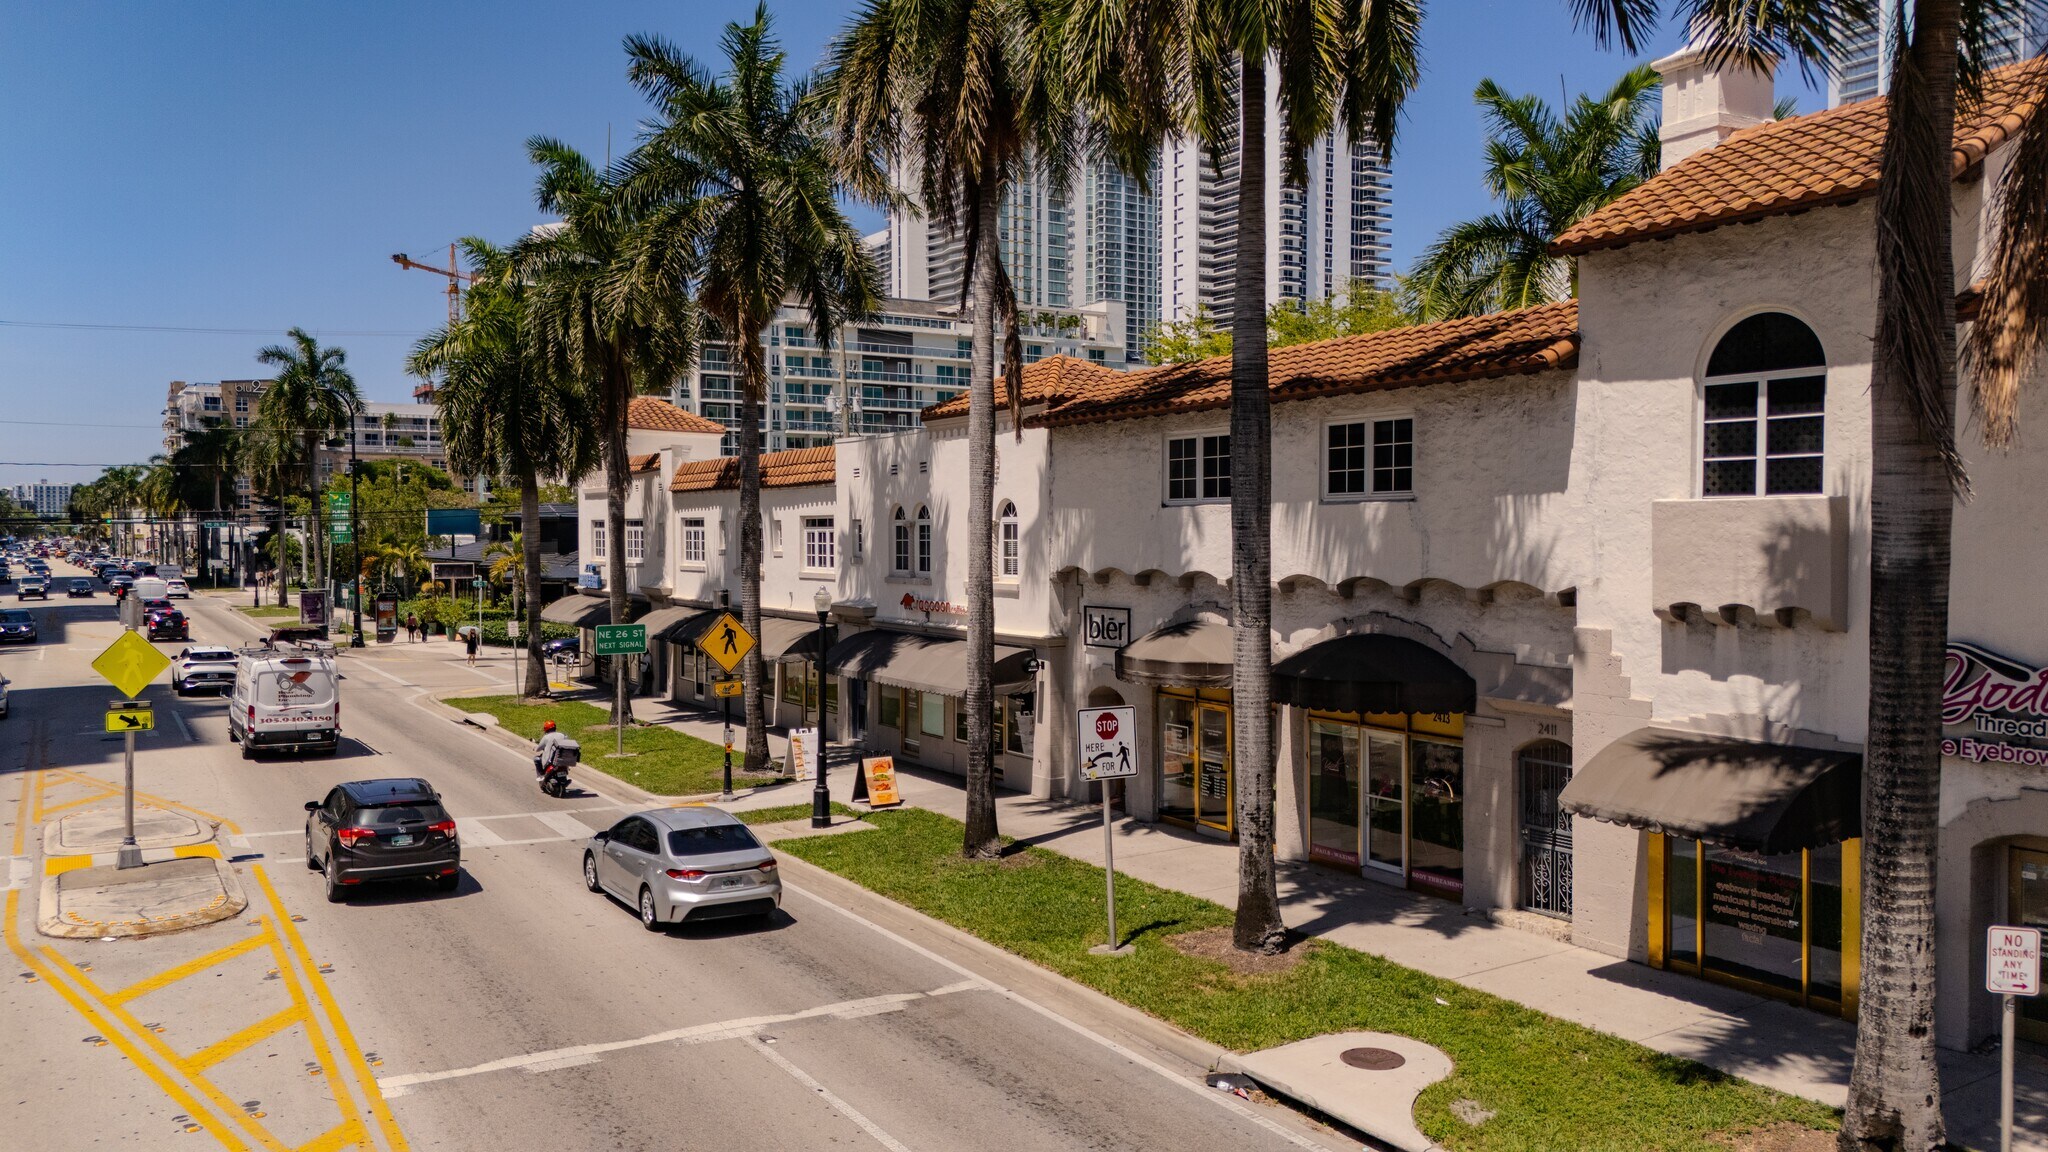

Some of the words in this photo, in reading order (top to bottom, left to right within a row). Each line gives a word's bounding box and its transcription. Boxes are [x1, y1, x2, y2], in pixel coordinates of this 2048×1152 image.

[915, 599, 951, 612] raccoon
[599, 630, 611, 639] NE
[616, 630, 628, 639] 26
[633, 629, 644, 638] ST
[1089, 614, 1126, 641] blēr
[620, 640, 644, 649] SIGNAL
[260, 716, 333, 724] 305.940.8180
[1433, 712, 1451, 725] 2413
[1097, 720, 1118, 733] STOP
[1537, 723, 1557, 736] 2411
[1086, 743, 1105, 753] HERE
[1103, 762, 1116, 772] FOR
[1716, 882, 1750, 895] eyebrow
[1750, 888, 1790, 906] threading
[1713, 892, 1750, 907] manicure
[1750, 899, 1757, 909] &
[1757, 903, 1794, 917] pedicure
[1712, 904, 1750, 919] eyelashes
[1738, 921, 1767, 937] waxing
[2004, 934, 2023, 948] NO
[1992, 948, 2035, 960] STANDING
[2003, 960, 2023, 970] ANY
[2001, 970, 2026, 981] TIME
